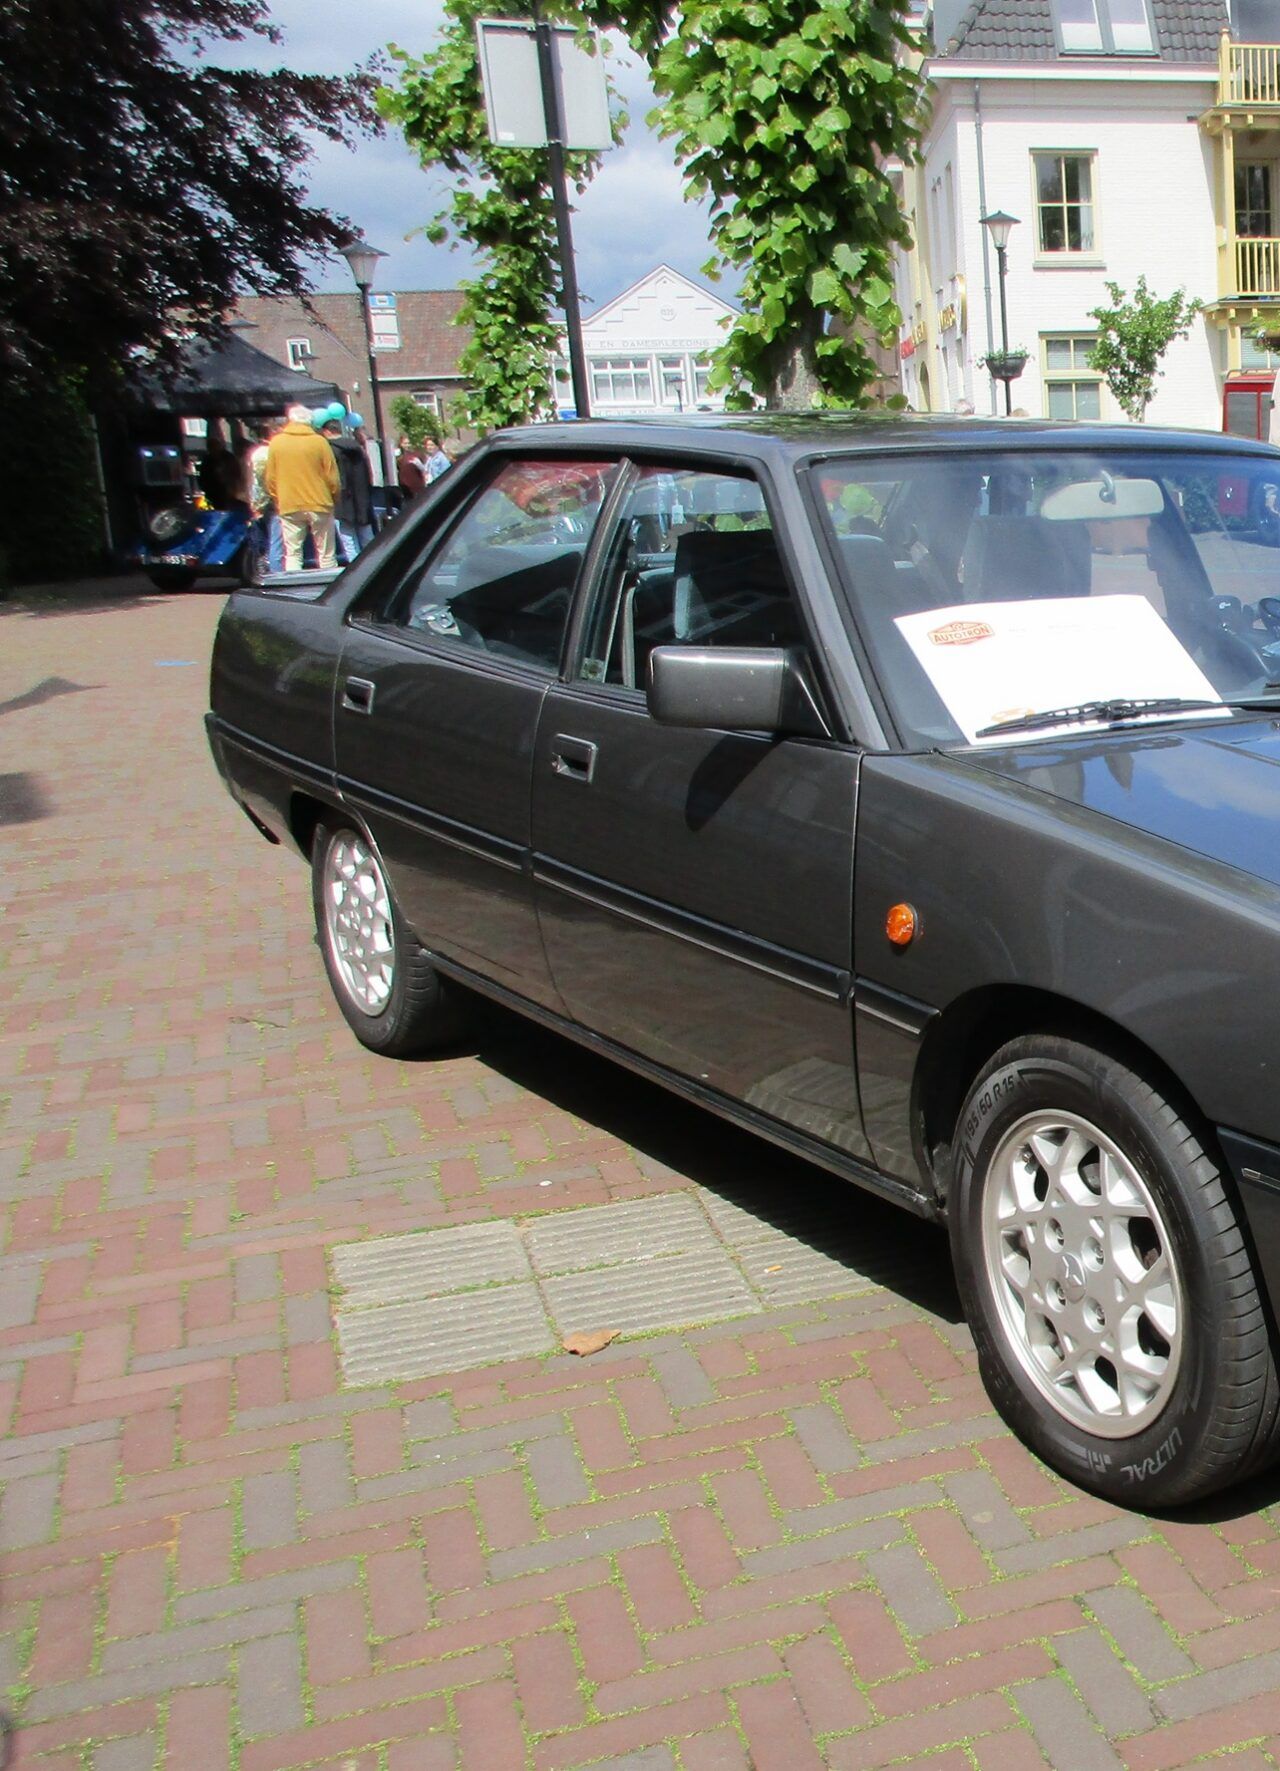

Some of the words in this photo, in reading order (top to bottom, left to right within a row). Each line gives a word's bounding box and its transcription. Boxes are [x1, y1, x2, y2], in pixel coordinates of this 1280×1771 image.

[622, 339, 710, 348] DAMESKLEEDING
[933, 624, 990, 643] AUTOTRON
[965, 1092, 993, 1140] 195/60
[1003, 1075, 1015, 1093] 15
